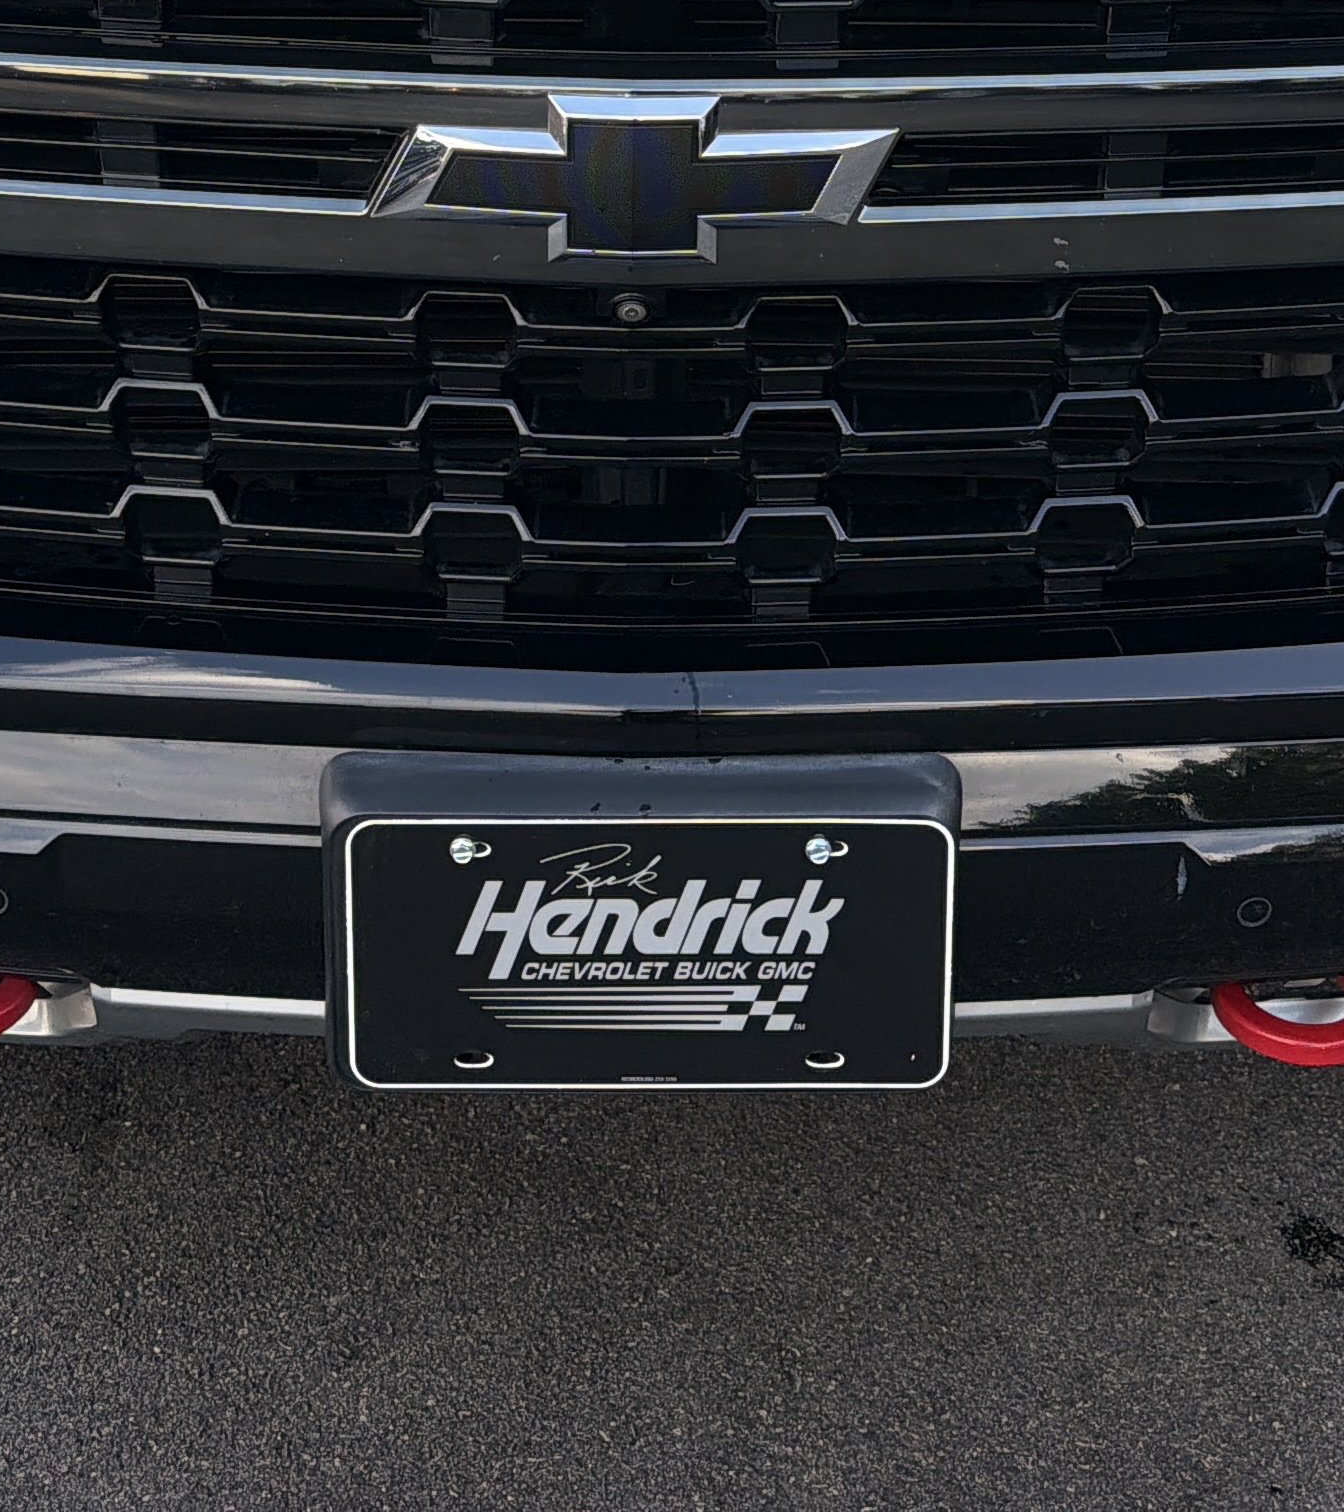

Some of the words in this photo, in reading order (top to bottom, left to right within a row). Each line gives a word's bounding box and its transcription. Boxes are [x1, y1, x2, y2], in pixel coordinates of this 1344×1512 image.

[454, 879, 846, 981] Hendrick
[520, 960, 668, 981] CHEVROLET
[672, 961, 753, 981] BUICK
[757, 961, 817, 981] GMC
